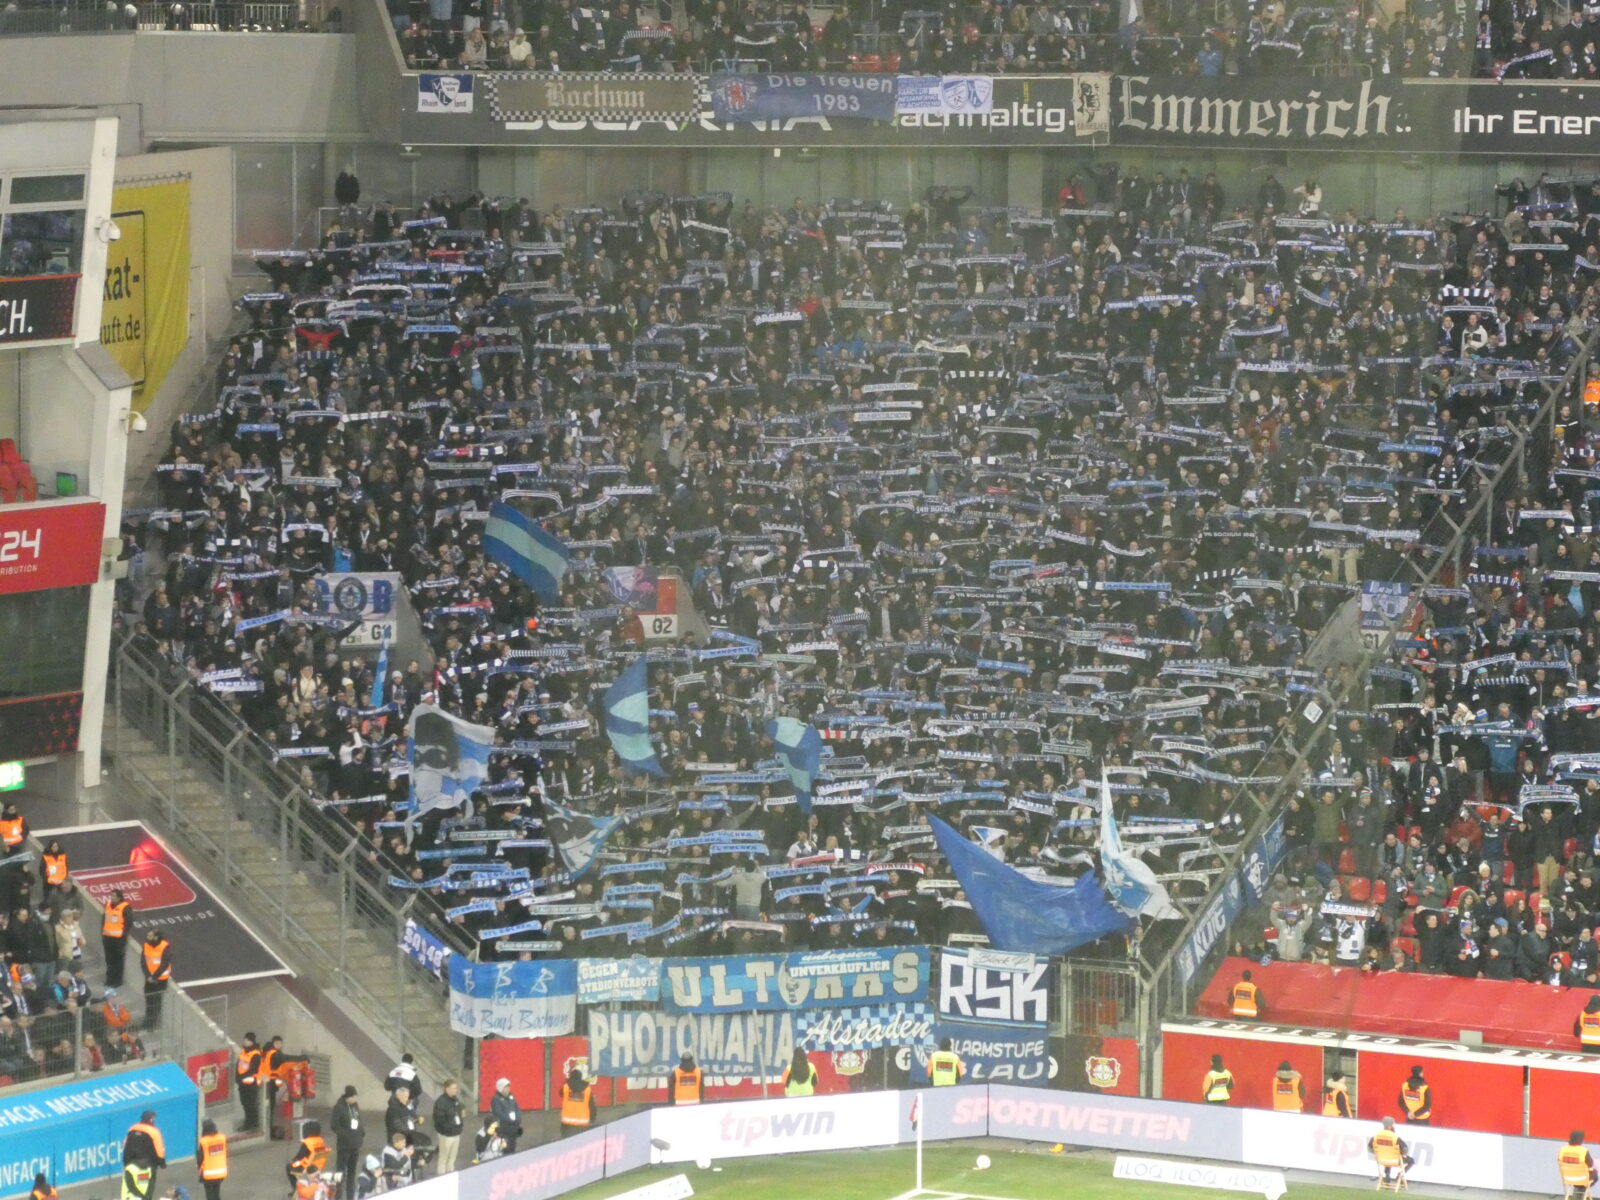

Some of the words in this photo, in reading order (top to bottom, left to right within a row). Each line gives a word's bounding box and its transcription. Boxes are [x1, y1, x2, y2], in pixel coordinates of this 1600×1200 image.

[544, 81, 646, 109] Bochum
[768, 74, 807, 89] Die
[819, 75, 893, 94] Treuen
[812, 94, 861, 112] 1983
[1117, 74, 1392, 139] Emmerich
[1454, 107, 1504, 133] Ihr
[589, 1010, 794, 1072] PHOTOMAFIA
[800, 1010, 932, 1047] Alstaden
[45, 1078, 169, 1115] MENSCHLICH.
[719, 1110, 836, 1147] tipwin
[952, 1098, 1192, 1143] SPORTWETTEN
[489, 1136, 624, 1200] SPORTWETTEN
